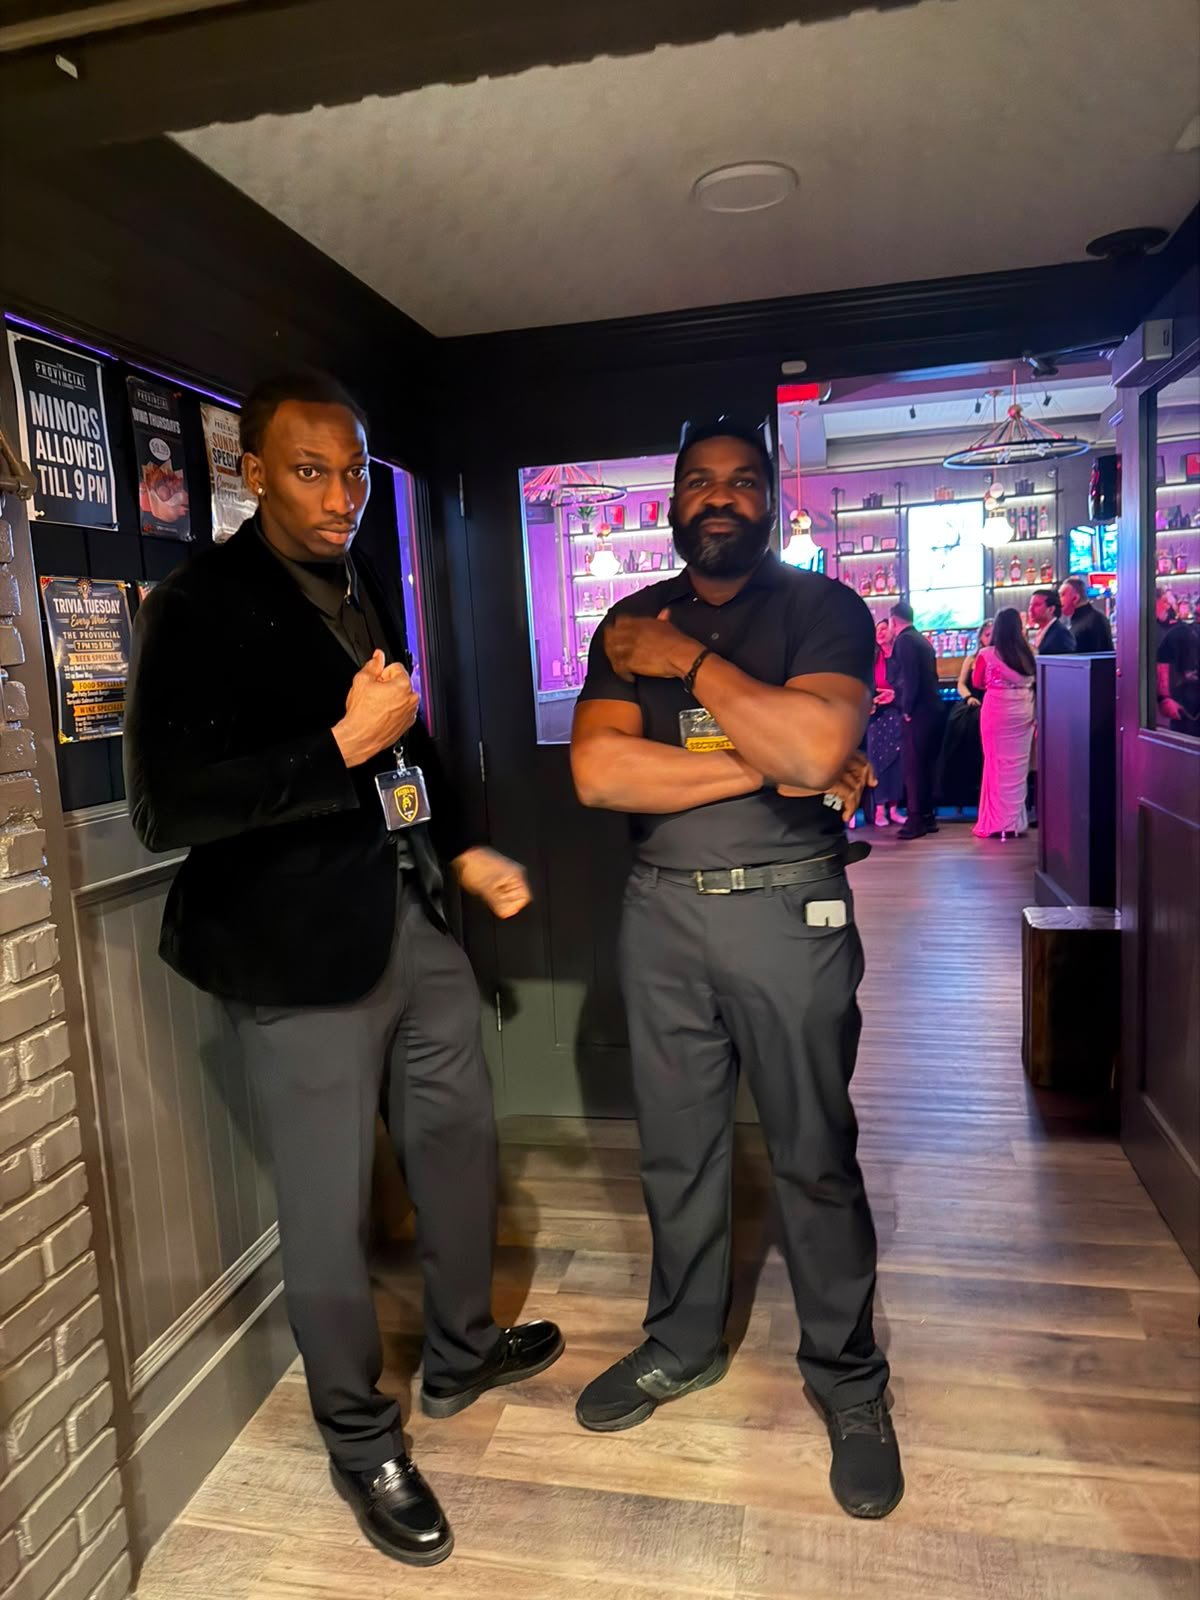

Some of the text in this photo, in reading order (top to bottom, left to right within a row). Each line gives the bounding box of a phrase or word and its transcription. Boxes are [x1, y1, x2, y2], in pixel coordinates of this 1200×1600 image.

[35, 363, 87, 388] PROVINCIAL
[29, 390, 101, 440] MINORS
[131, 407, 181, 434] WING THURSDAYS
[36, 430, 105, 471] ALLOWED
[212, 432, 240, 454] SUNDA
[37, 464, 108, 505] TILL 9 PM
[53, 598, 121, 614] TRIVIA TUESDAY
[70, 614, 109, 629] Every Week
[62, 631, 121, 639] THE PROVINCIAL
[104, 641, 113, 649] PM
[75, 653, 119, 662] BEER SPECIALS
[80, 706, 96, 714] WINE
